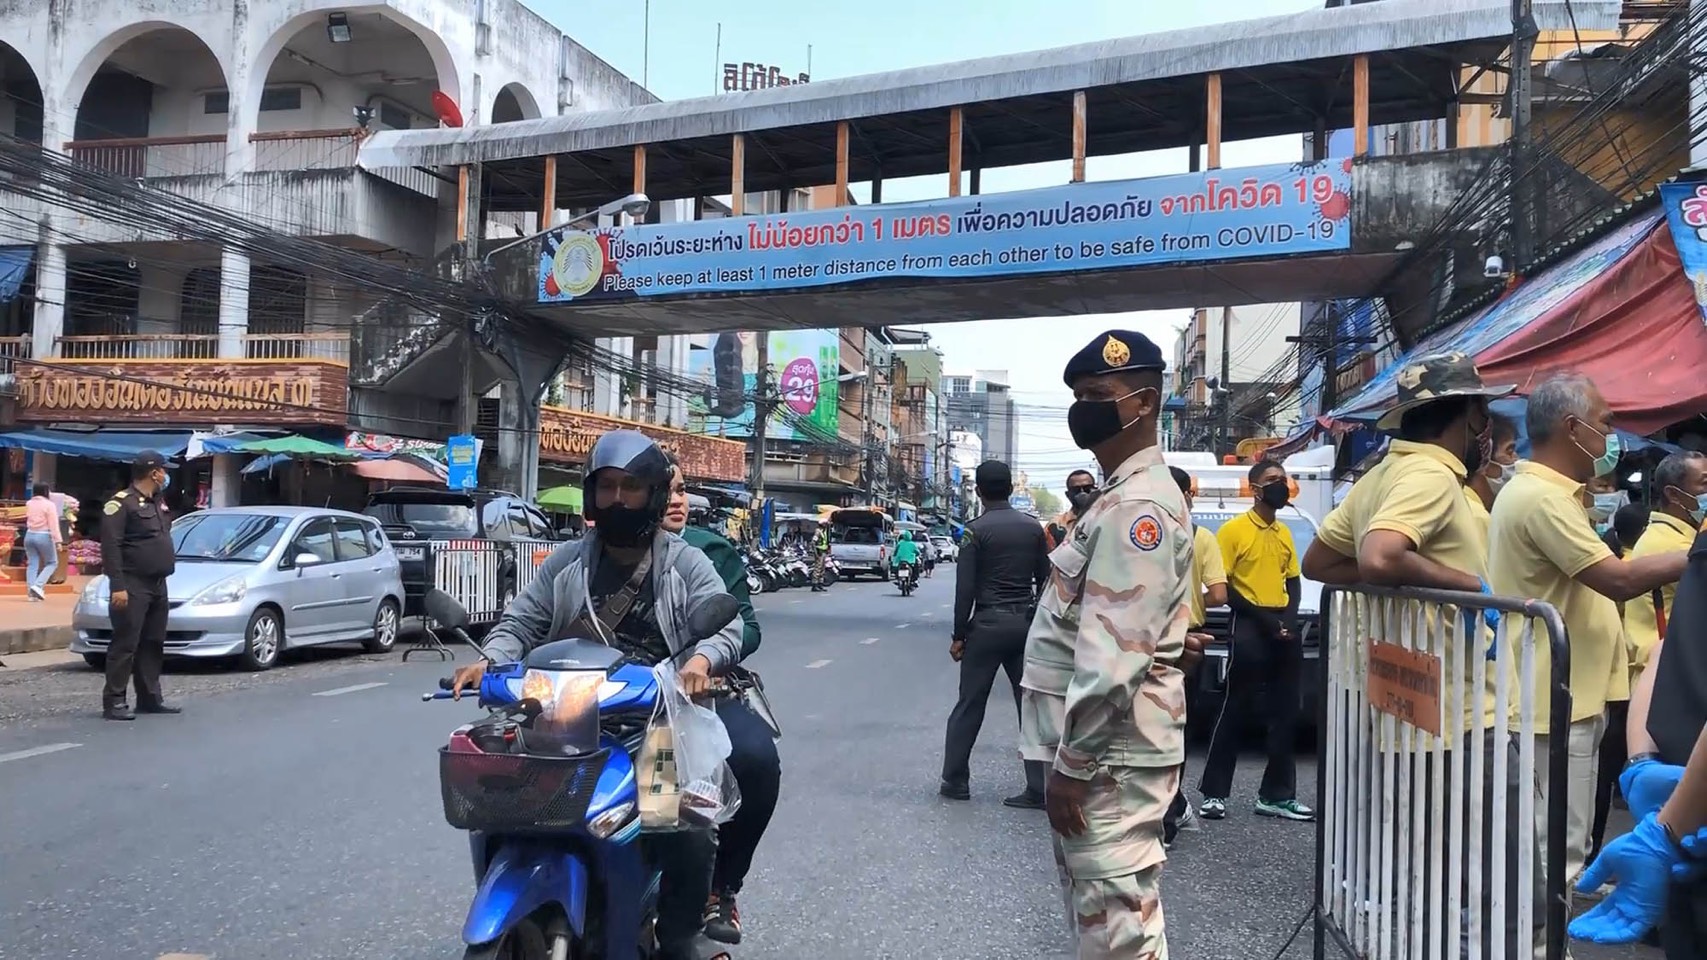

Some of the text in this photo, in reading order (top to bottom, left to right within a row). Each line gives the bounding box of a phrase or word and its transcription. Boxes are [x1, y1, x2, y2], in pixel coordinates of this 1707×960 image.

[604, 274, 653, 291] Please
[657, 272, 693, 287] keep
[697, 269, 712, 283] at
[717, 266, 754, 282] least
[759, 266, 767, 280] 1
[773, 264, 820, 280] meter
[824, 257, 896, 276] distance
[902, 254, 942, 269] from
[949, 249, 992, 267] each
[998, 246, 1048, 264] other
[1054, 244, 1073, 260] to
[1081, 241, 1105, 258] be
[1111, 236, 1154, 255] safe
[1161, 233, 1210, 251] from
[1217, 220, 1334, 247] COVID-19
[608, 229, 743, 261] โปรดเว้นระยะห่าง
[748, 214, 864, 249] ไม่น้อยกว่า
[871, 217, 882, 240] 1
[893, 213, 951, 239] เมตร
[957, 195, 1152, 234] เพื่อความปลอดภัย
[1160, 178, 1282, 215] จากโควิด
[1294, 174, 1333, 203] 19
